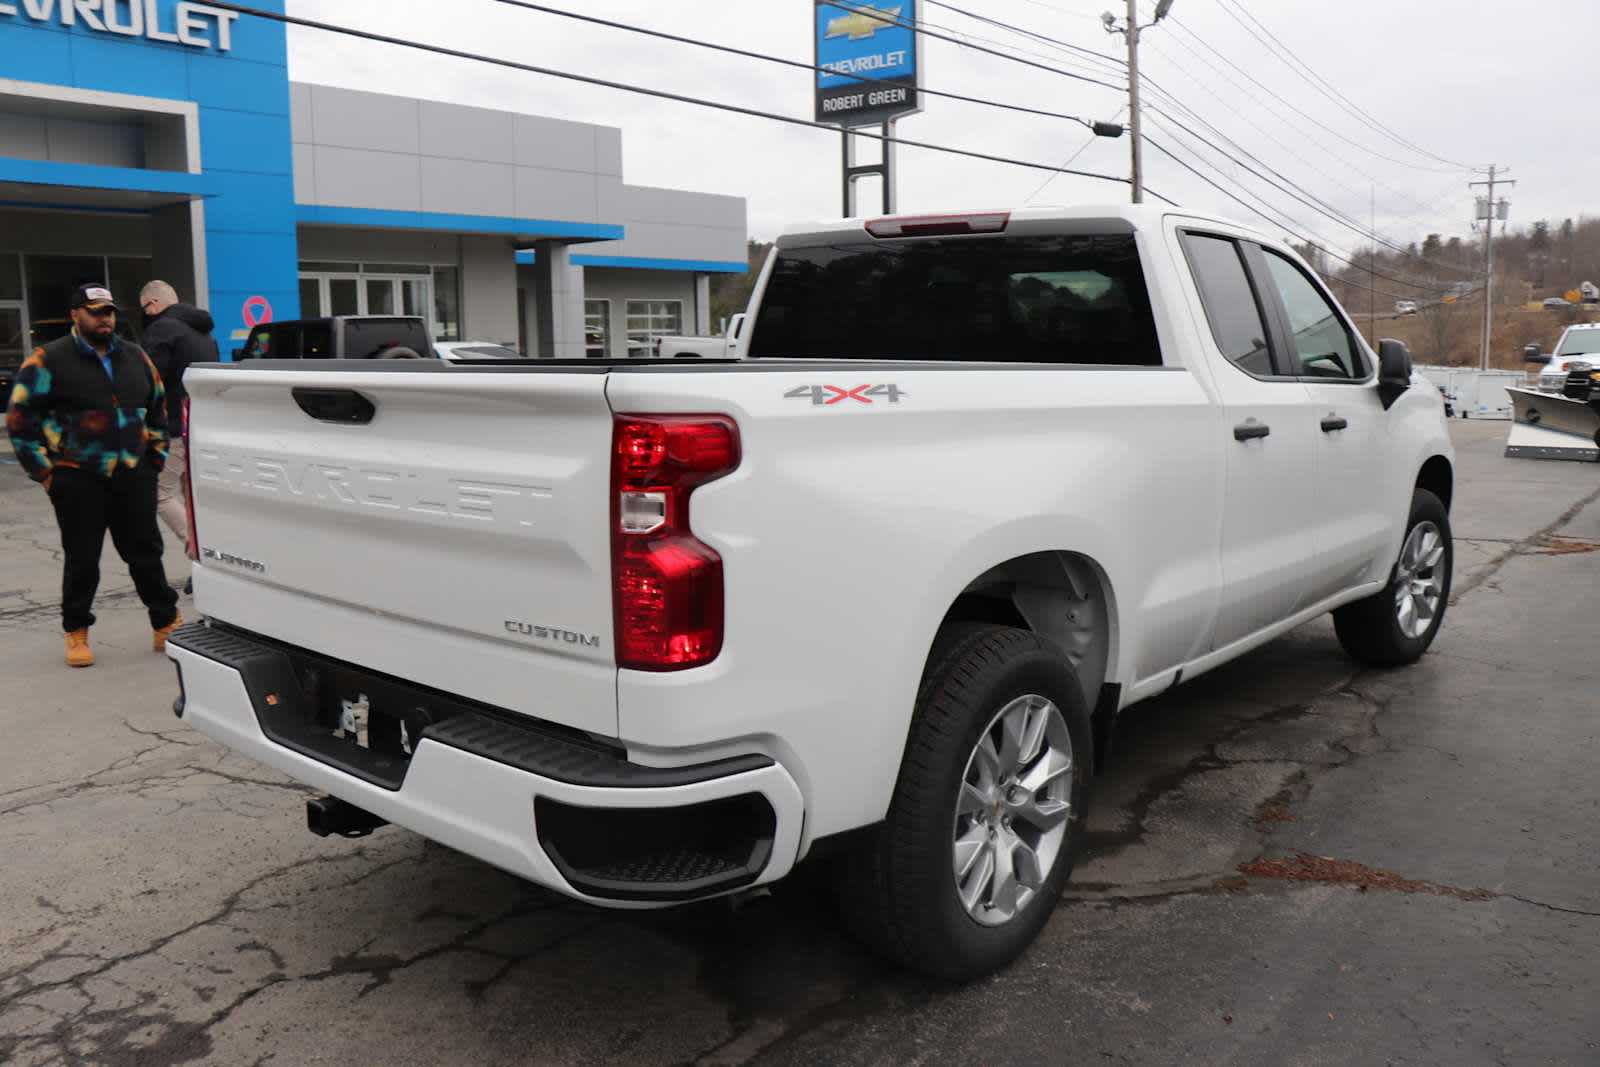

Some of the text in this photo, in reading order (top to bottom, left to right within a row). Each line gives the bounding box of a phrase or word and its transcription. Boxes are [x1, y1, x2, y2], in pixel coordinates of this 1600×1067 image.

[821, 50, 907, 78] CHEVROLET
[823, 88, 907, 113] ROBERT GREEN
[198, 449, 553, 526] CHEVROLET
[503, 619, 600, 648] CUSTOM
